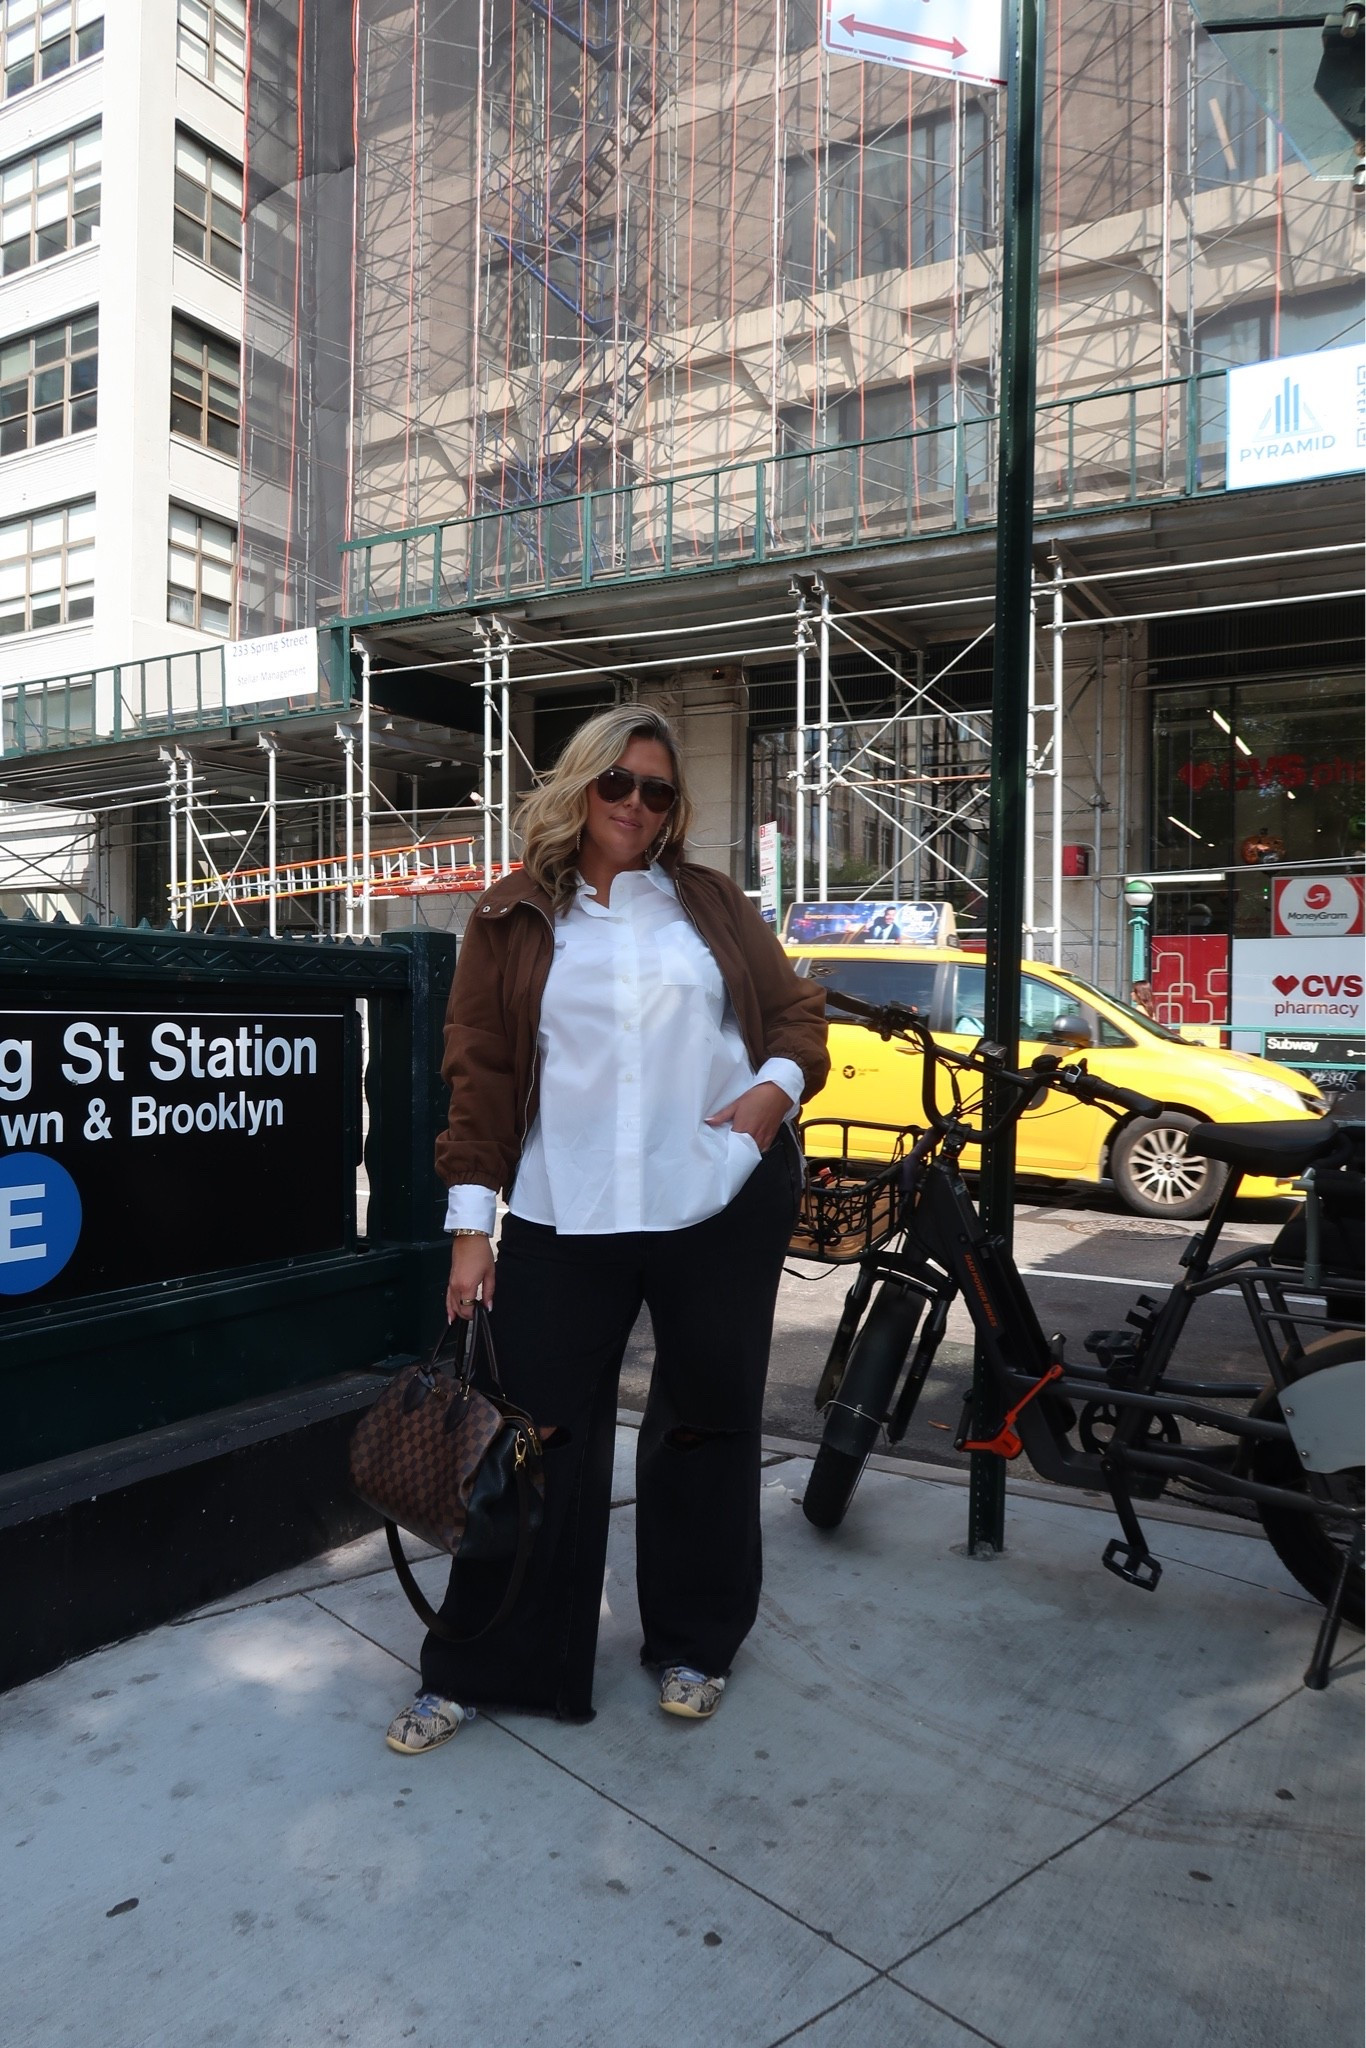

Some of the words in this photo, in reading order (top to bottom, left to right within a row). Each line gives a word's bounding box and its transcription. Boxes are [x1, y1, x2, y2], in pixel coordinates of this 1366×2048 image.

[1239, 435, 1336, 463] PYRAMID
[251, 640, 279, 657] Spring
[281, 634, 308, 649] Street
[1219, 754, 1307, 790] CVS
[1287, 911, 1349, 922] MoneyGram
[1302, 975, 1364, 998] CVS
[1274, 1001, 1359, 1018] pharmacy
[61, 1021, 125, 1085] St
[149, 1022, 318, 1082] Station
[1267, 1038, 1319, 1054] Subway
[83, 1097, 113, 1141] &
[131, 1090, 284, 1137] Brooklyn
[0, 1183, 47, 1264] E
